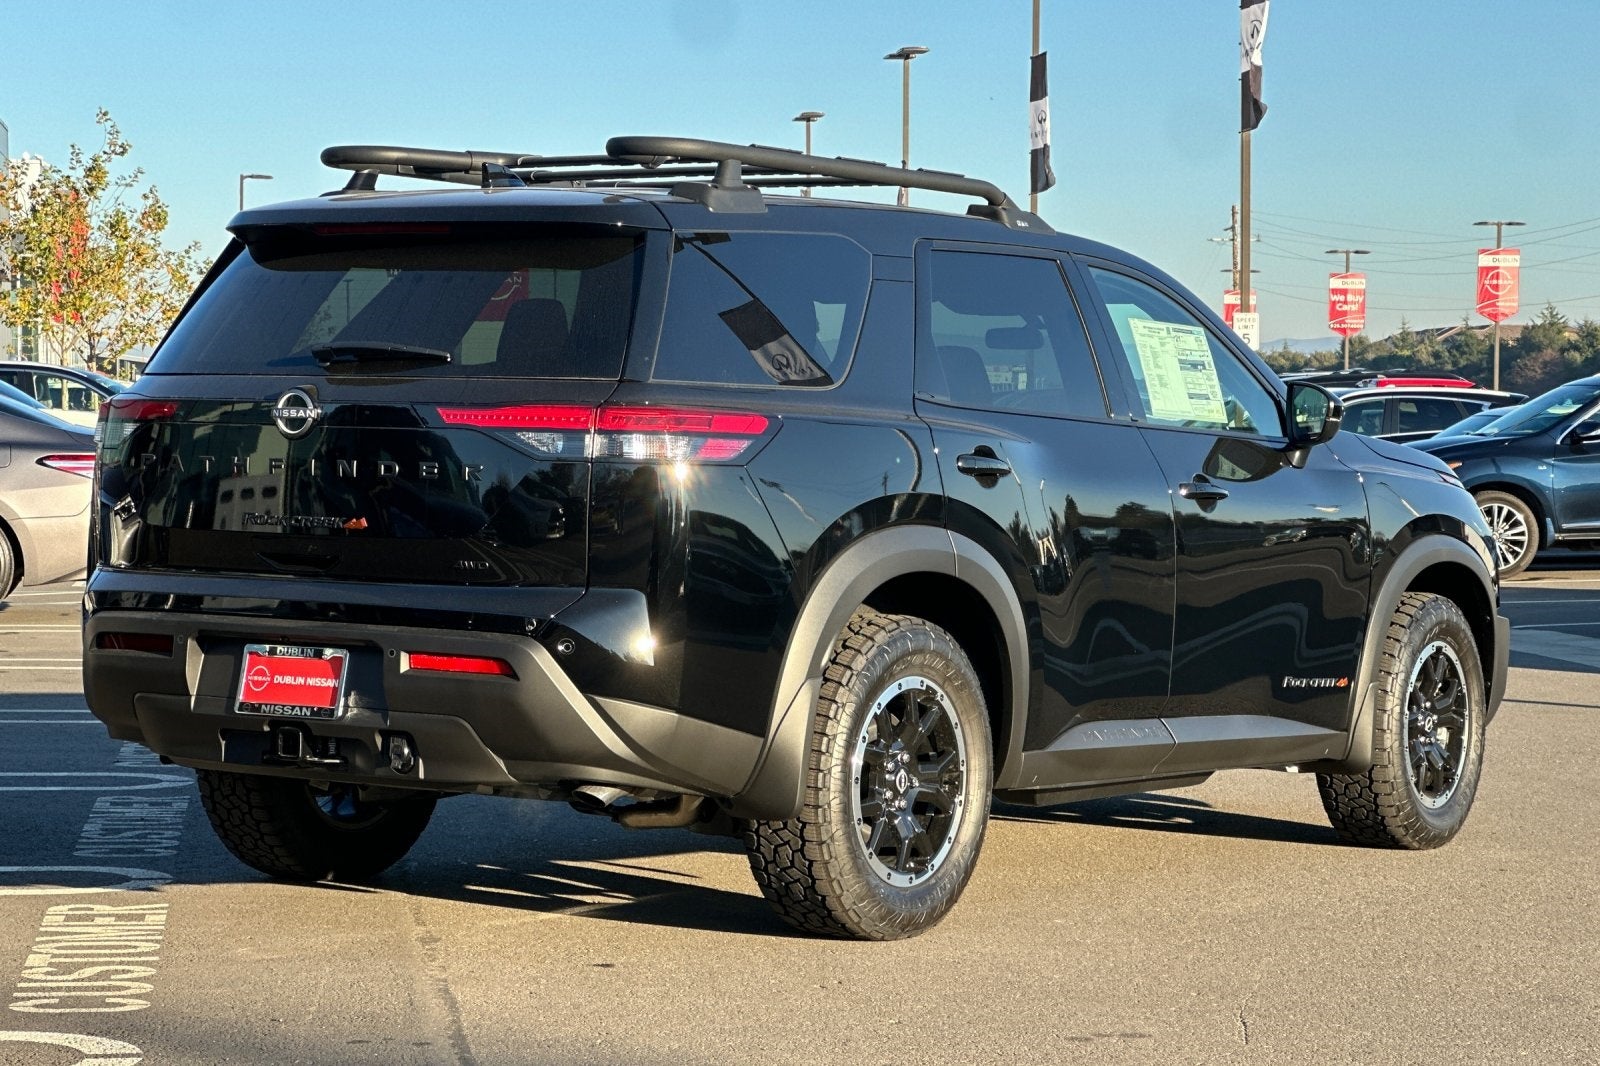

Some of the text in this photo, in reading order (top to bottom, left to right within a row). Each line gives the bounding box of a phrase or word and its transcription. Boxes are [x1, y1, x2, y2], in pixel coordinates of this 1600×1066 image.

[1330, 294, 1364, 304] We Buy
[1242, 333, 1251, 345] 5
[273, 409, 315, 419] NISSAN
[139, 452, 485, 482] PATHFINDER
[276, 646, 315, 658] DUBLIN
[247, 674, 271, 682] NISSAN
[273, 674, 339, 688] DUBLIN NISSAN
[260, 703, 312, 717] NISSAN
[8, 902, 170, 1014] CUSTOMER
